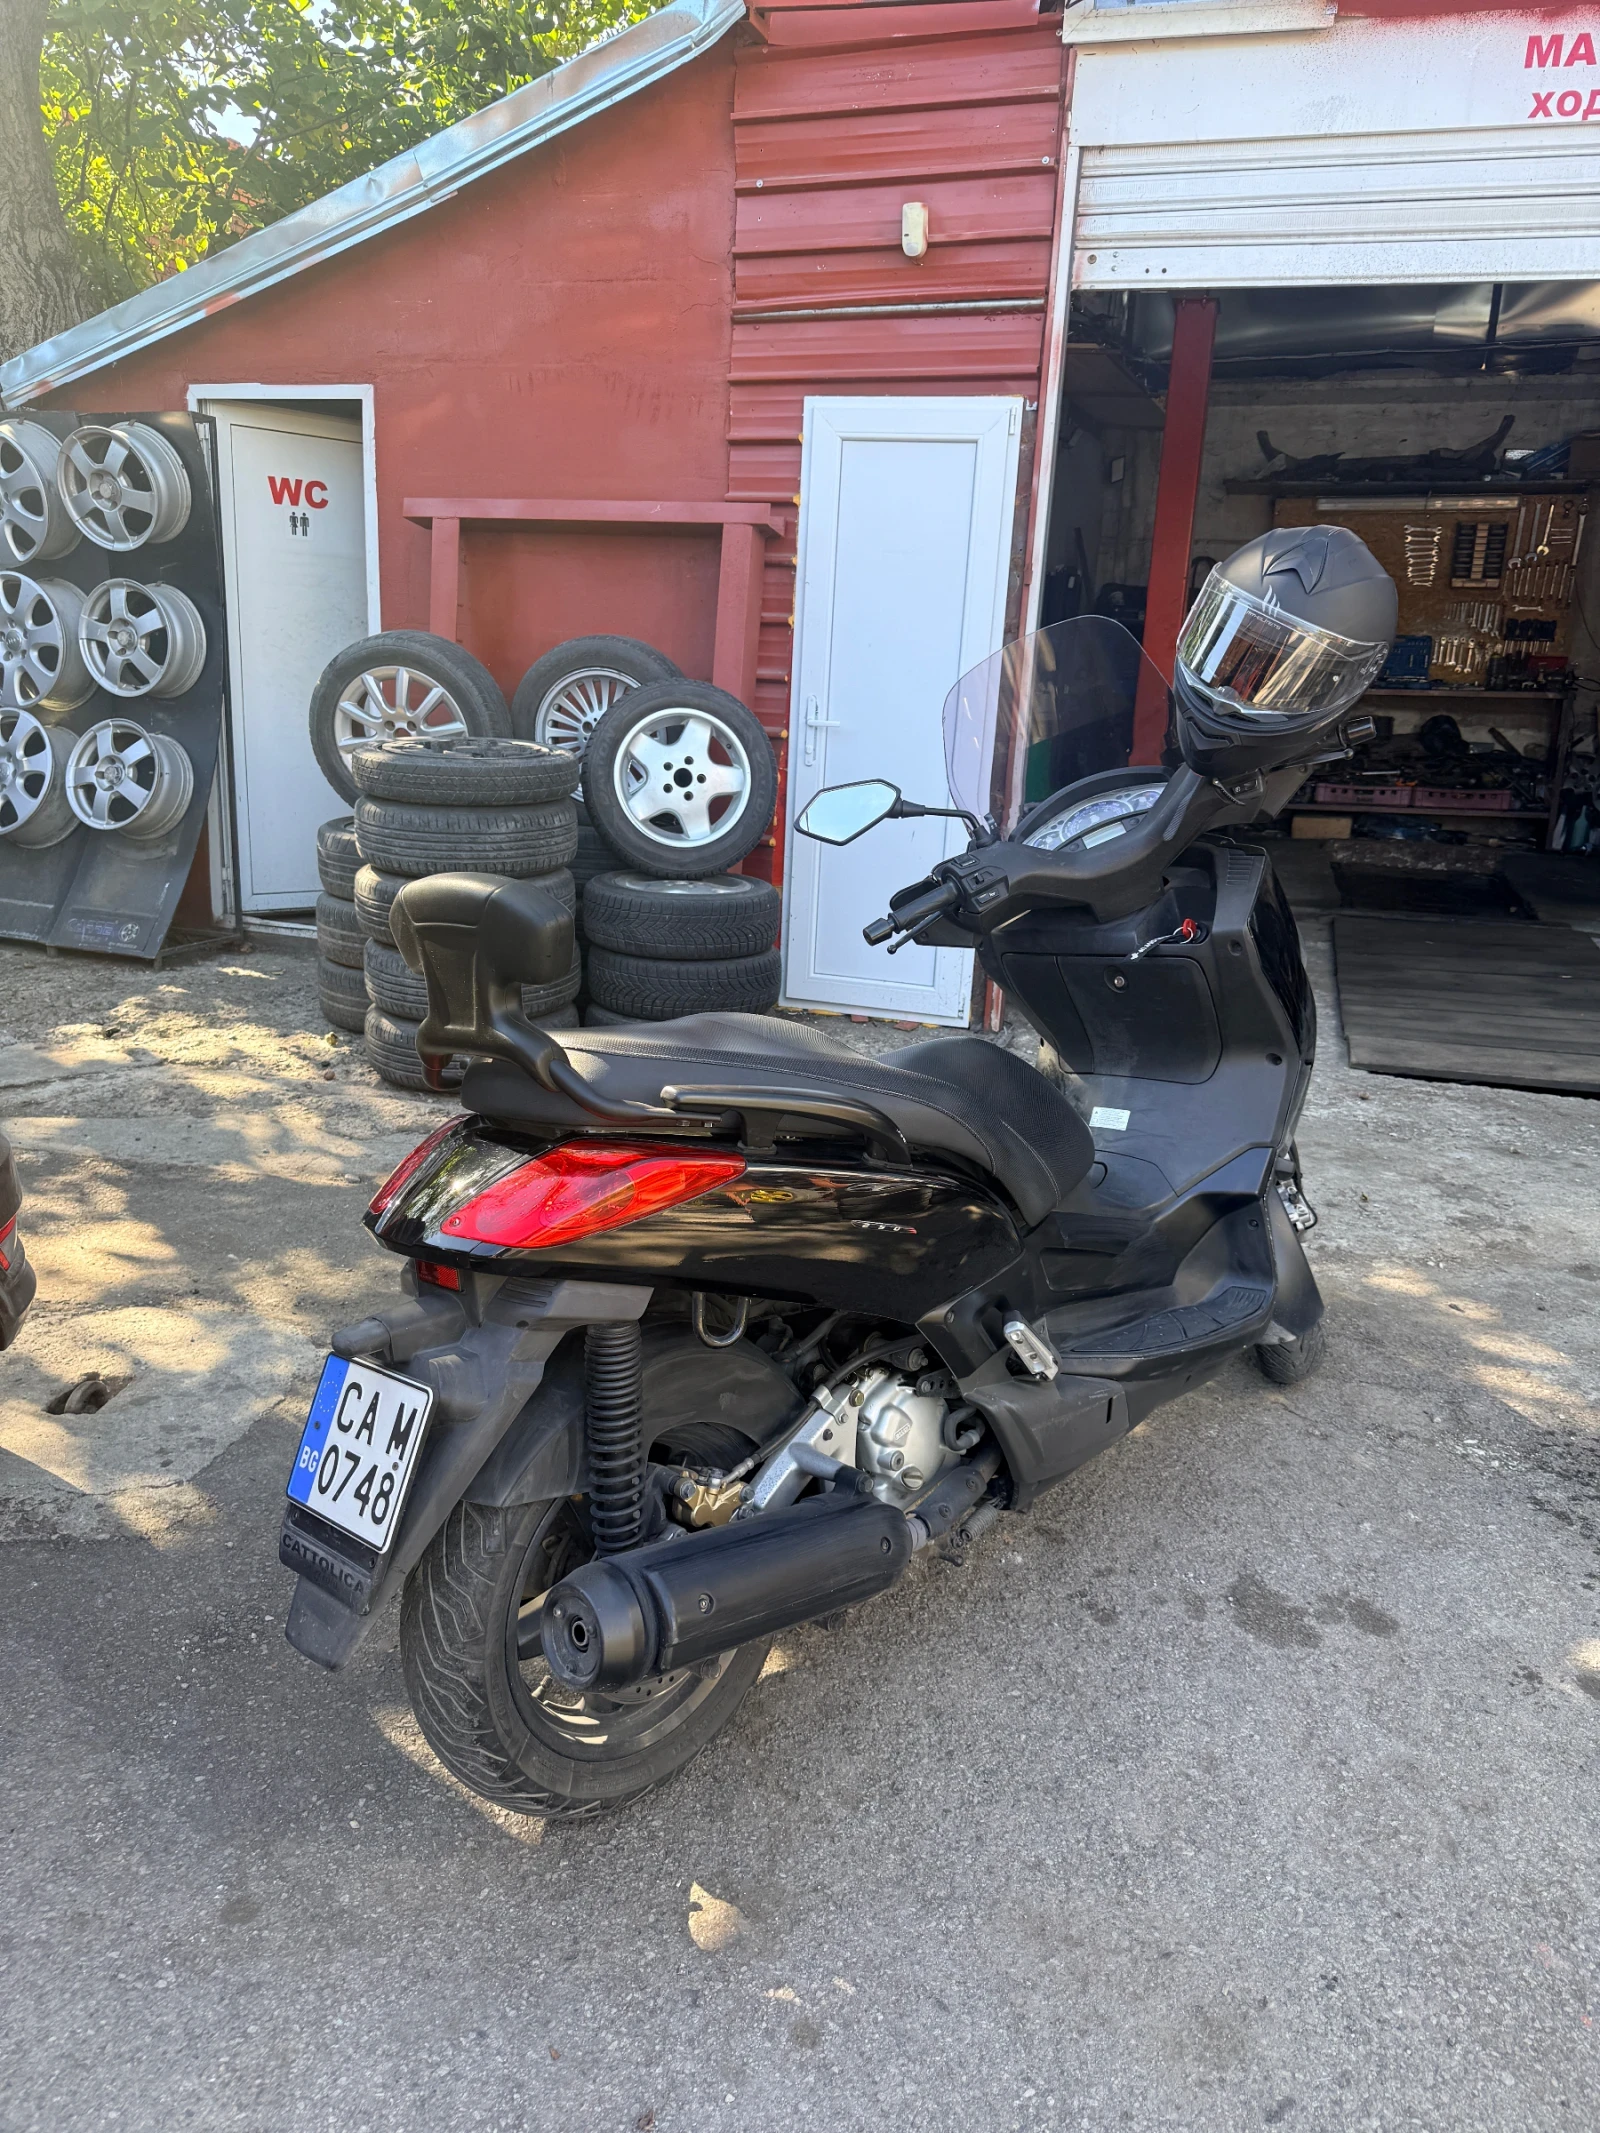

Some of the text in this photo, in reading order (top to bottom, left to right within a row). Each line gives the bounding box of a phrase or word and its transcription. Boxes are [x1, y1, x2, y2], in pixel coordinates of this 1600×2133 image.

[267, 475, 329, 510] WC
[337, 1381, 418, 1461] CA M
[299, 1446, 319, 1472] BG
[317, 1444, 395, 1525] 0748
[282, 1533, 364, 1593] CATTOLICA
